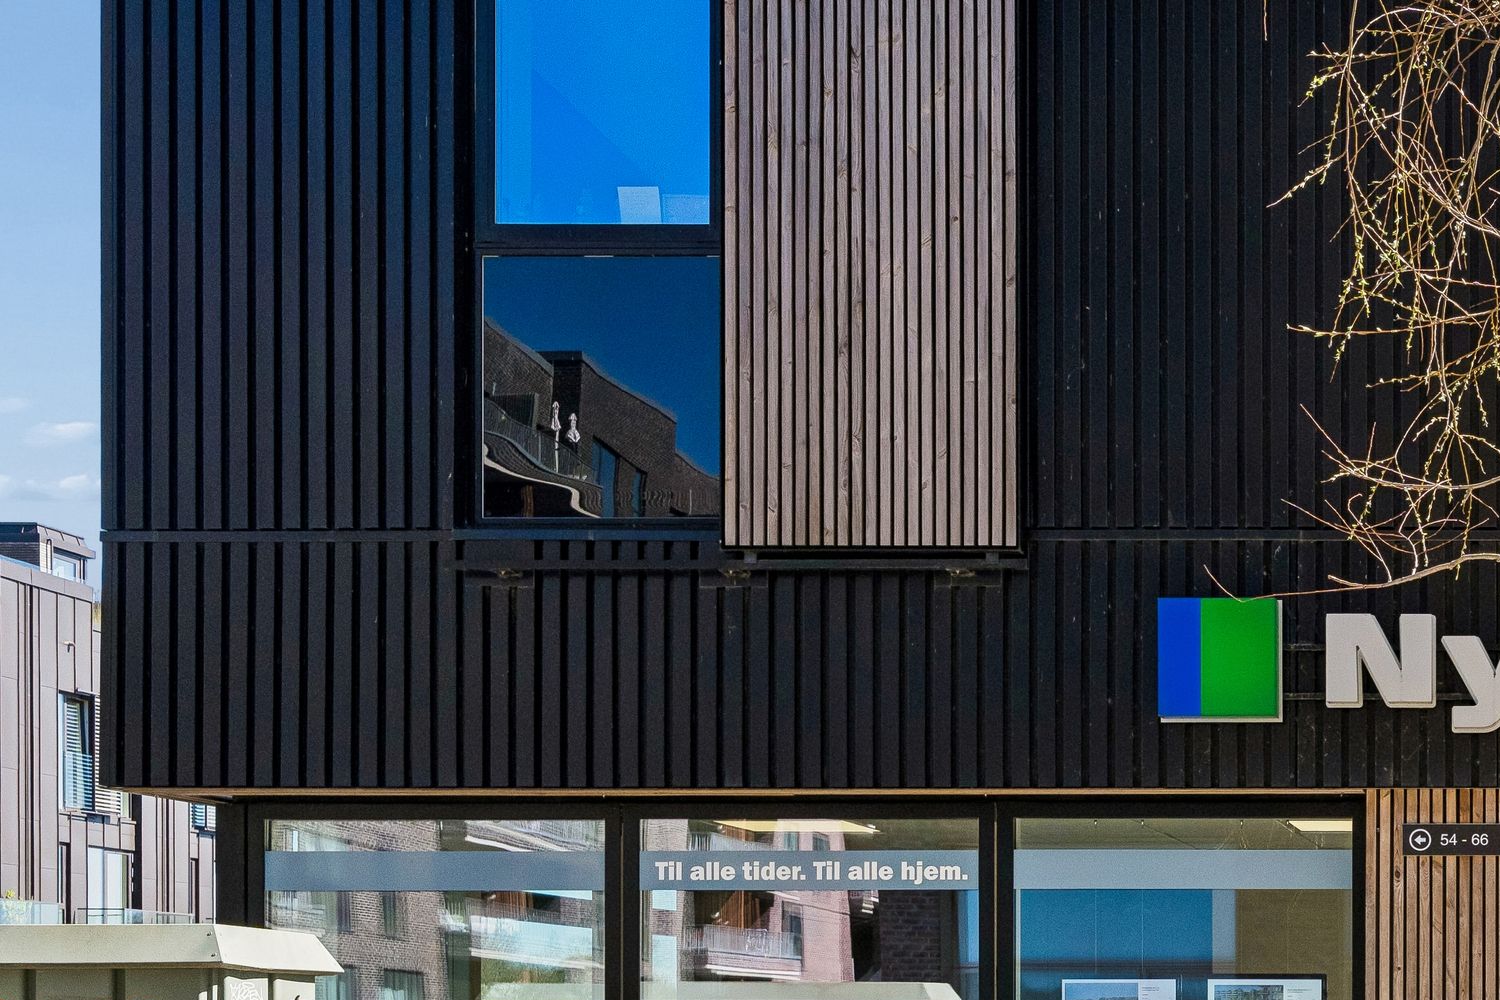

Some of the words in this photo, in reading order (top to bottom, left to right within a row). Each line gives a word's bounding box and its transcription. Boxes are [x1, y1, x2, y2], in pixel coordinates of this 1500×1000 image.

[1440, 833, 1458, 846] 54
[1471, 833, 1489, 846] 66
[655, 861, 682, 881] Til
[690, 861, 736, 881] alle
[742, 861, 806, 881] tider.
[812, 861, 840, 881] Til
[847, 861, 893, 881] alle
[901, 861, 968, 885] hjem.
